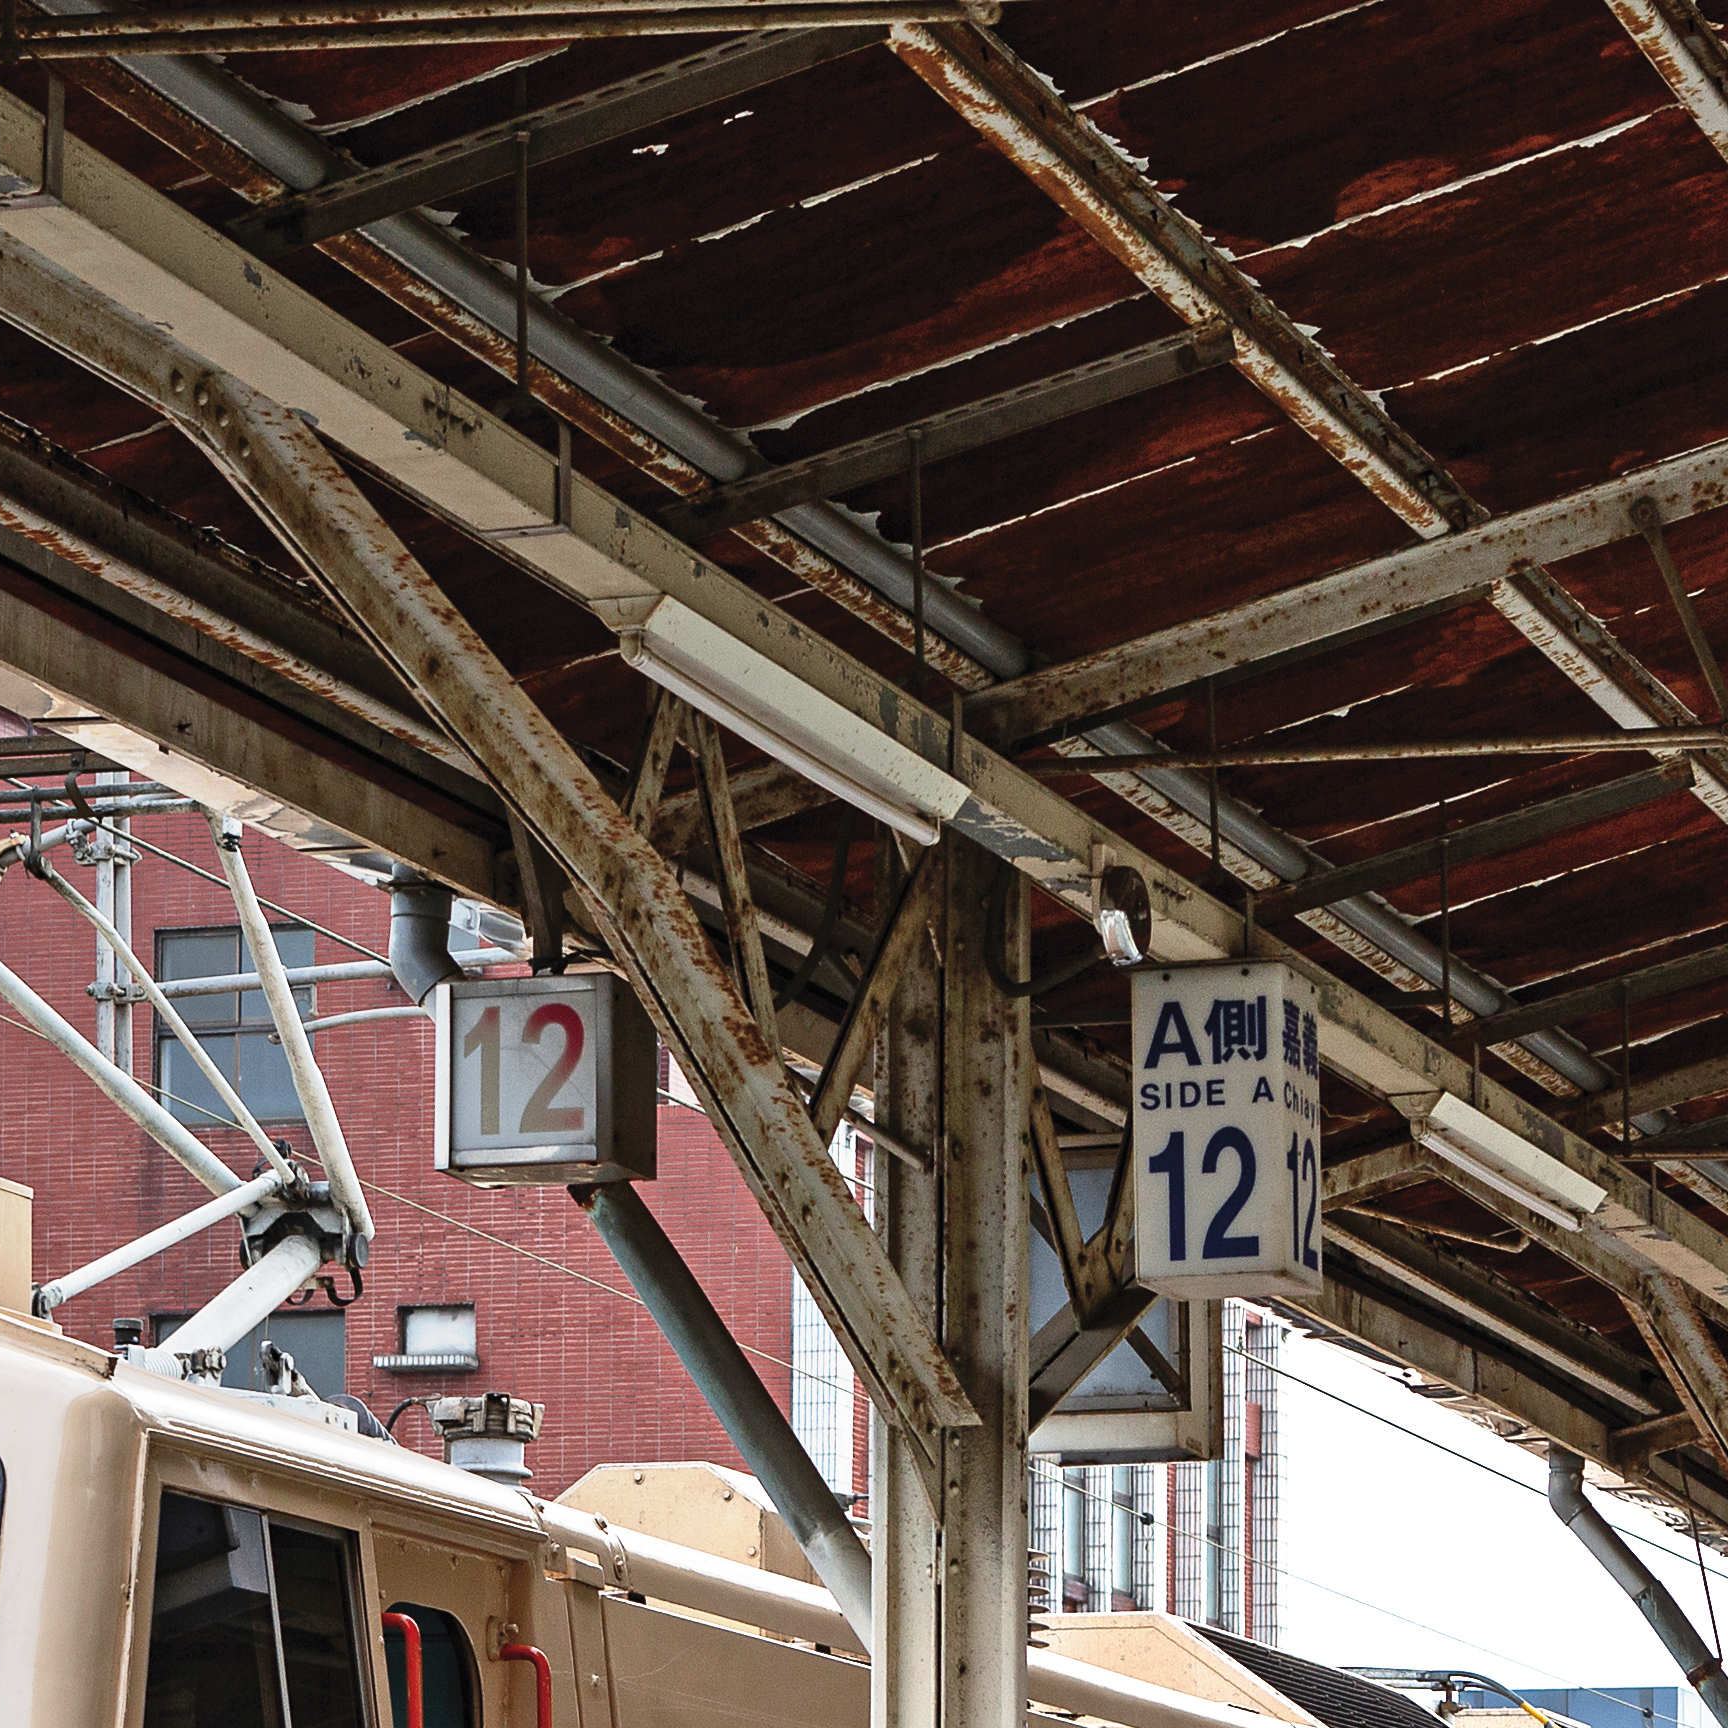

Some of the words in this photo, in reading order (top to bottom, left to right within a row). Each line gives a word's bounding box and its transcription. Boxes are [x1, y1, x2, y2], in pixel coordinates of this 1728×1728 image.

[464, 1003, 585, 1136] 12
[1143, 995, 1268, 1069] A側
[1282, 999, 1318, 1080] 嘉義
[1140, 1079, 1226, 1111] SIDE
[1252, 1076, 1274, 1104] A
[1148, 1125, 1260, 1262] 12
[1287, 1131, 1319, 1272] 12
